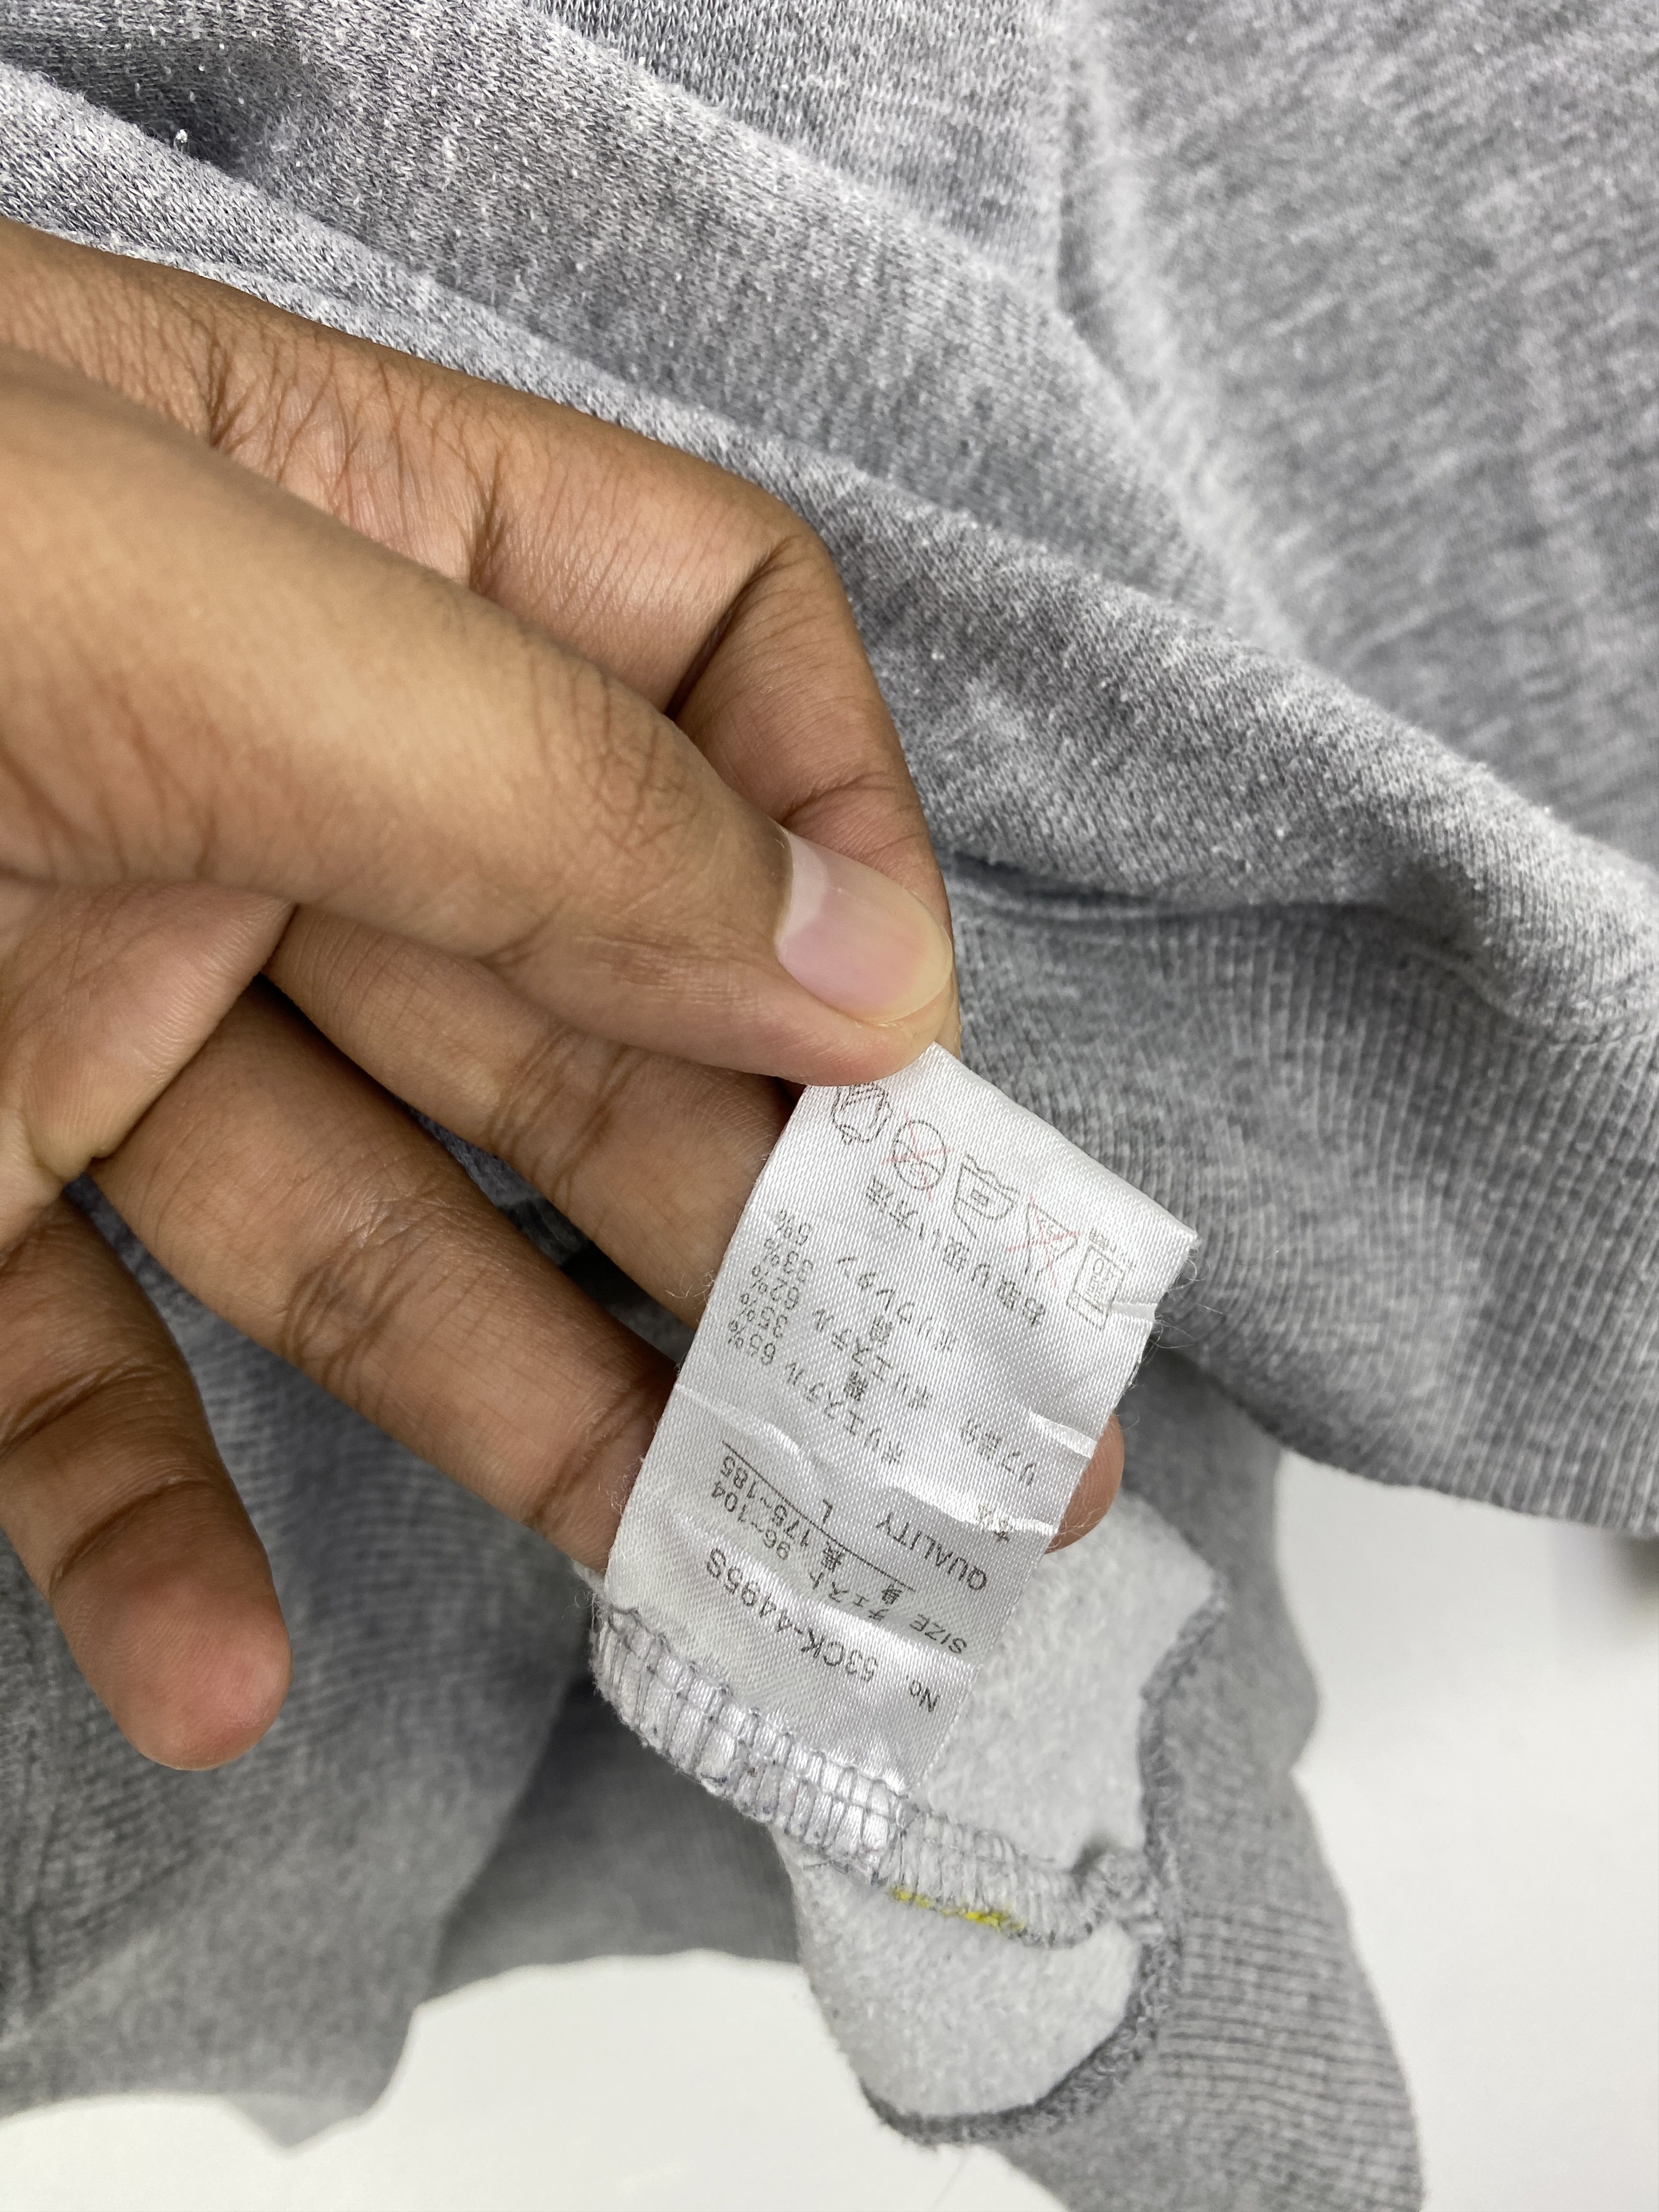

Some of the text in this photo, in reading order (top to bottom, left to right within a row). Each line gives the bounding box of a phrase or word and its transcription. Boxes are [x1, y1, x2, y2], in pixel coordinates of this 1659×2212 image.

[761, 1236, 814, 1285] 33%
[775, 1208, 957, 1354] ポリウレタン 5%
[865, 1174, 1047, 1328] お取り扱い方法
[738, 1292, 789, 1339] 35%
[749, 1264, 933, 1411] ポリエステル 62%
[726, 1319, 906, 1466] ポリエステル 65%
[821, 1497, 834, 1525] L
[874, 1510, 988, 1592] QUALITY
[704, 1546, 879, 1684] 53CK-4495S
[808, 1570, 890, 1625] チェスト
[907, 1612, 968, 1656] SIZE
